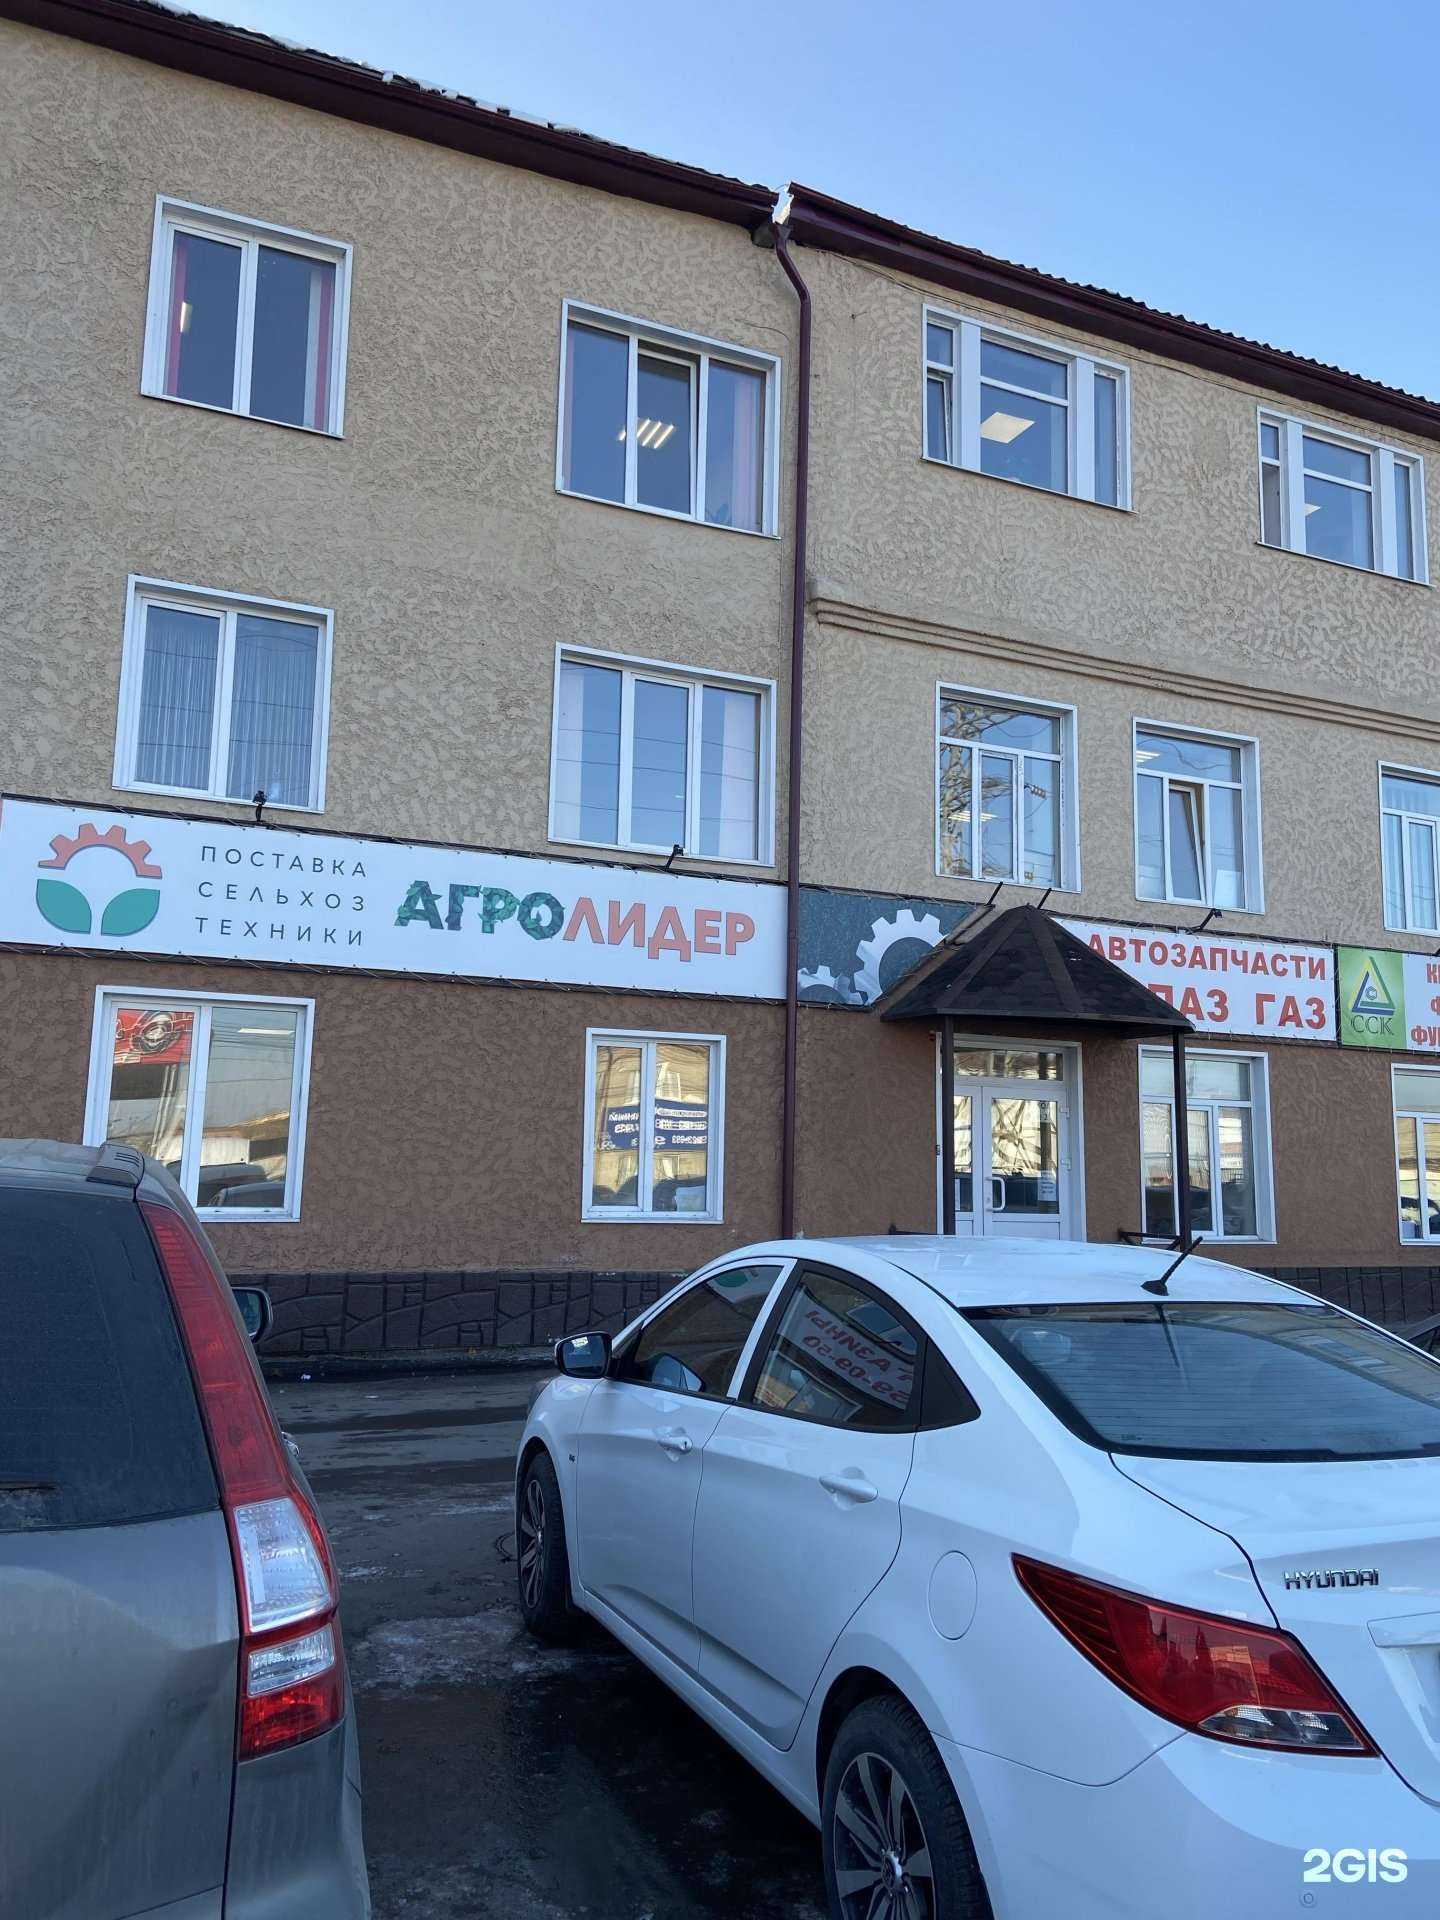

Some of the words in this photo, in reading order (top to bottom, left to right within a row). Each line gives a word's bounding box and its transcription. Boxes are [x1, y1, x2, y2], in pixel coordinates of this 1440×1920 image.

[201, 846, 367, 878] ПОСТАВКА
[198, 881, 365, 912] СЕЛЬХОЗ
[194, 917, 362, 947] ТЕХНИКИ
[394, 880, 756, 963] АГРОЛИДЕР
[1088, 934, 1326, 981] АВТОЗАПЧАСТИ
[1255, 992, 1327, 1031] ГАЗ
[1410, 1025, 1440, 1047] ФУ
[1284, 1568, 1380, 1590] HYUNDAI
